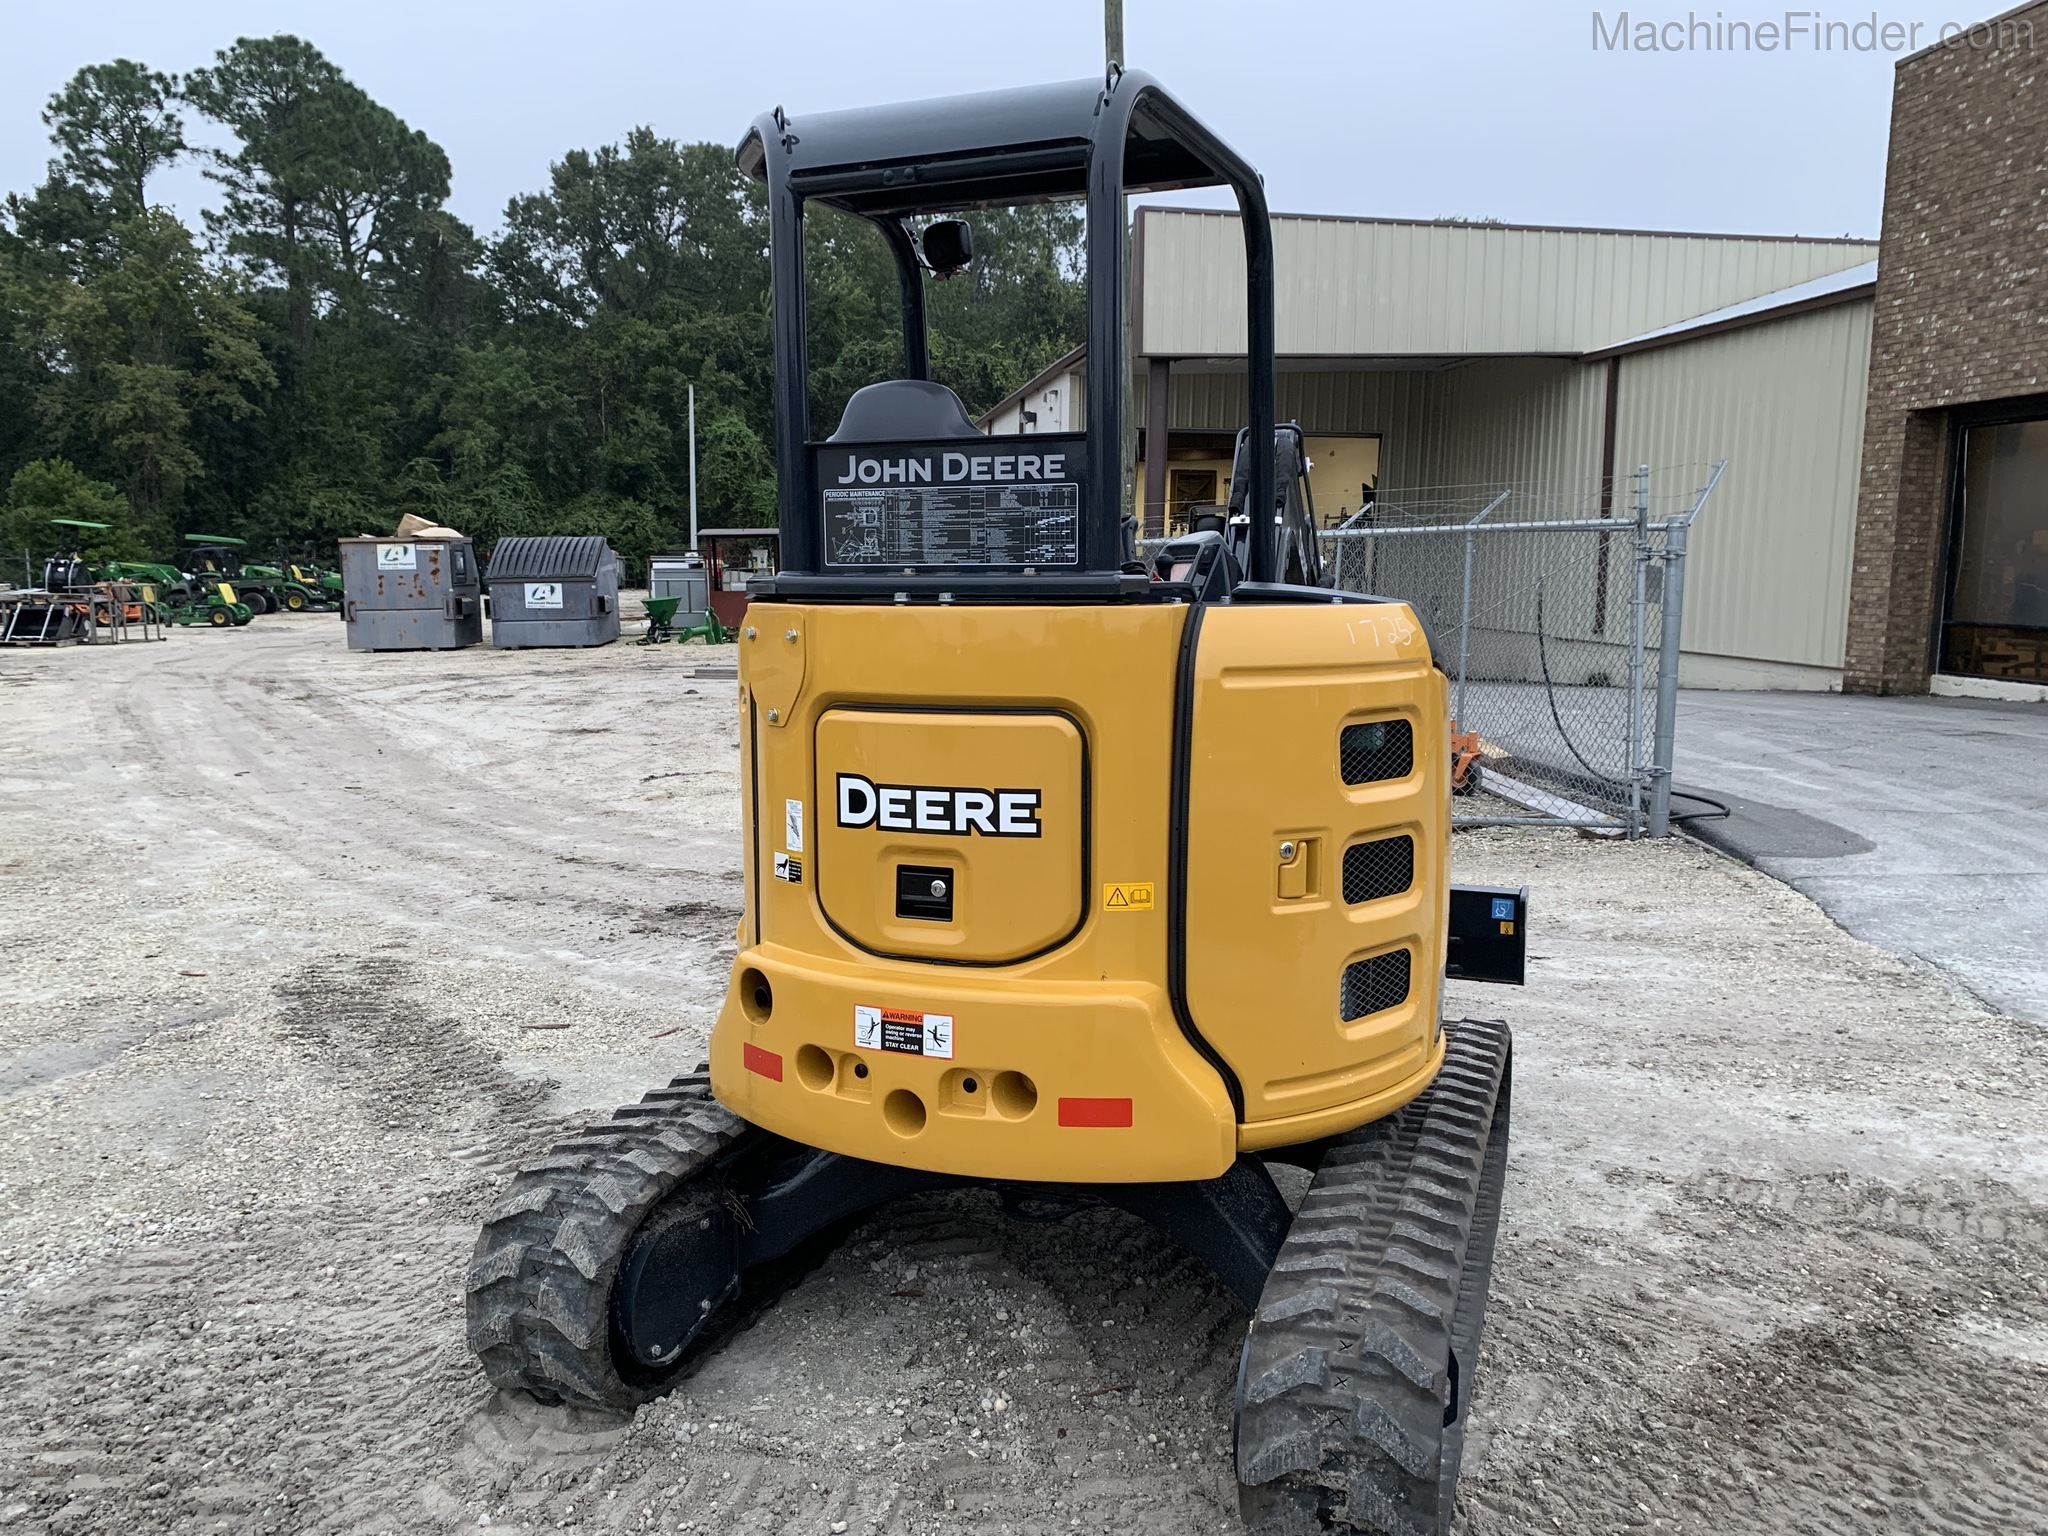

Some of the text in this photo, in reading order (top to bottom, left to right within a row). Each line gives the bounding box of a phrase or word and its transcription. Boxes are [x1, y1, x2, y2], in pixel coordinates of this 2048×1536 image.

[838, 452, 1066, 484] JOHN DEERE
[849, 490, 886, 498] MAINTENANCE
[1346, 616, 1412, 647] 1725
[837, 774, 1040, 837] DEERE
[888, 1012, 923, 1023] WARNING
[885, 1023, 905, 1031] Operator
[899, 1043, 919, 1051] CLEAR
